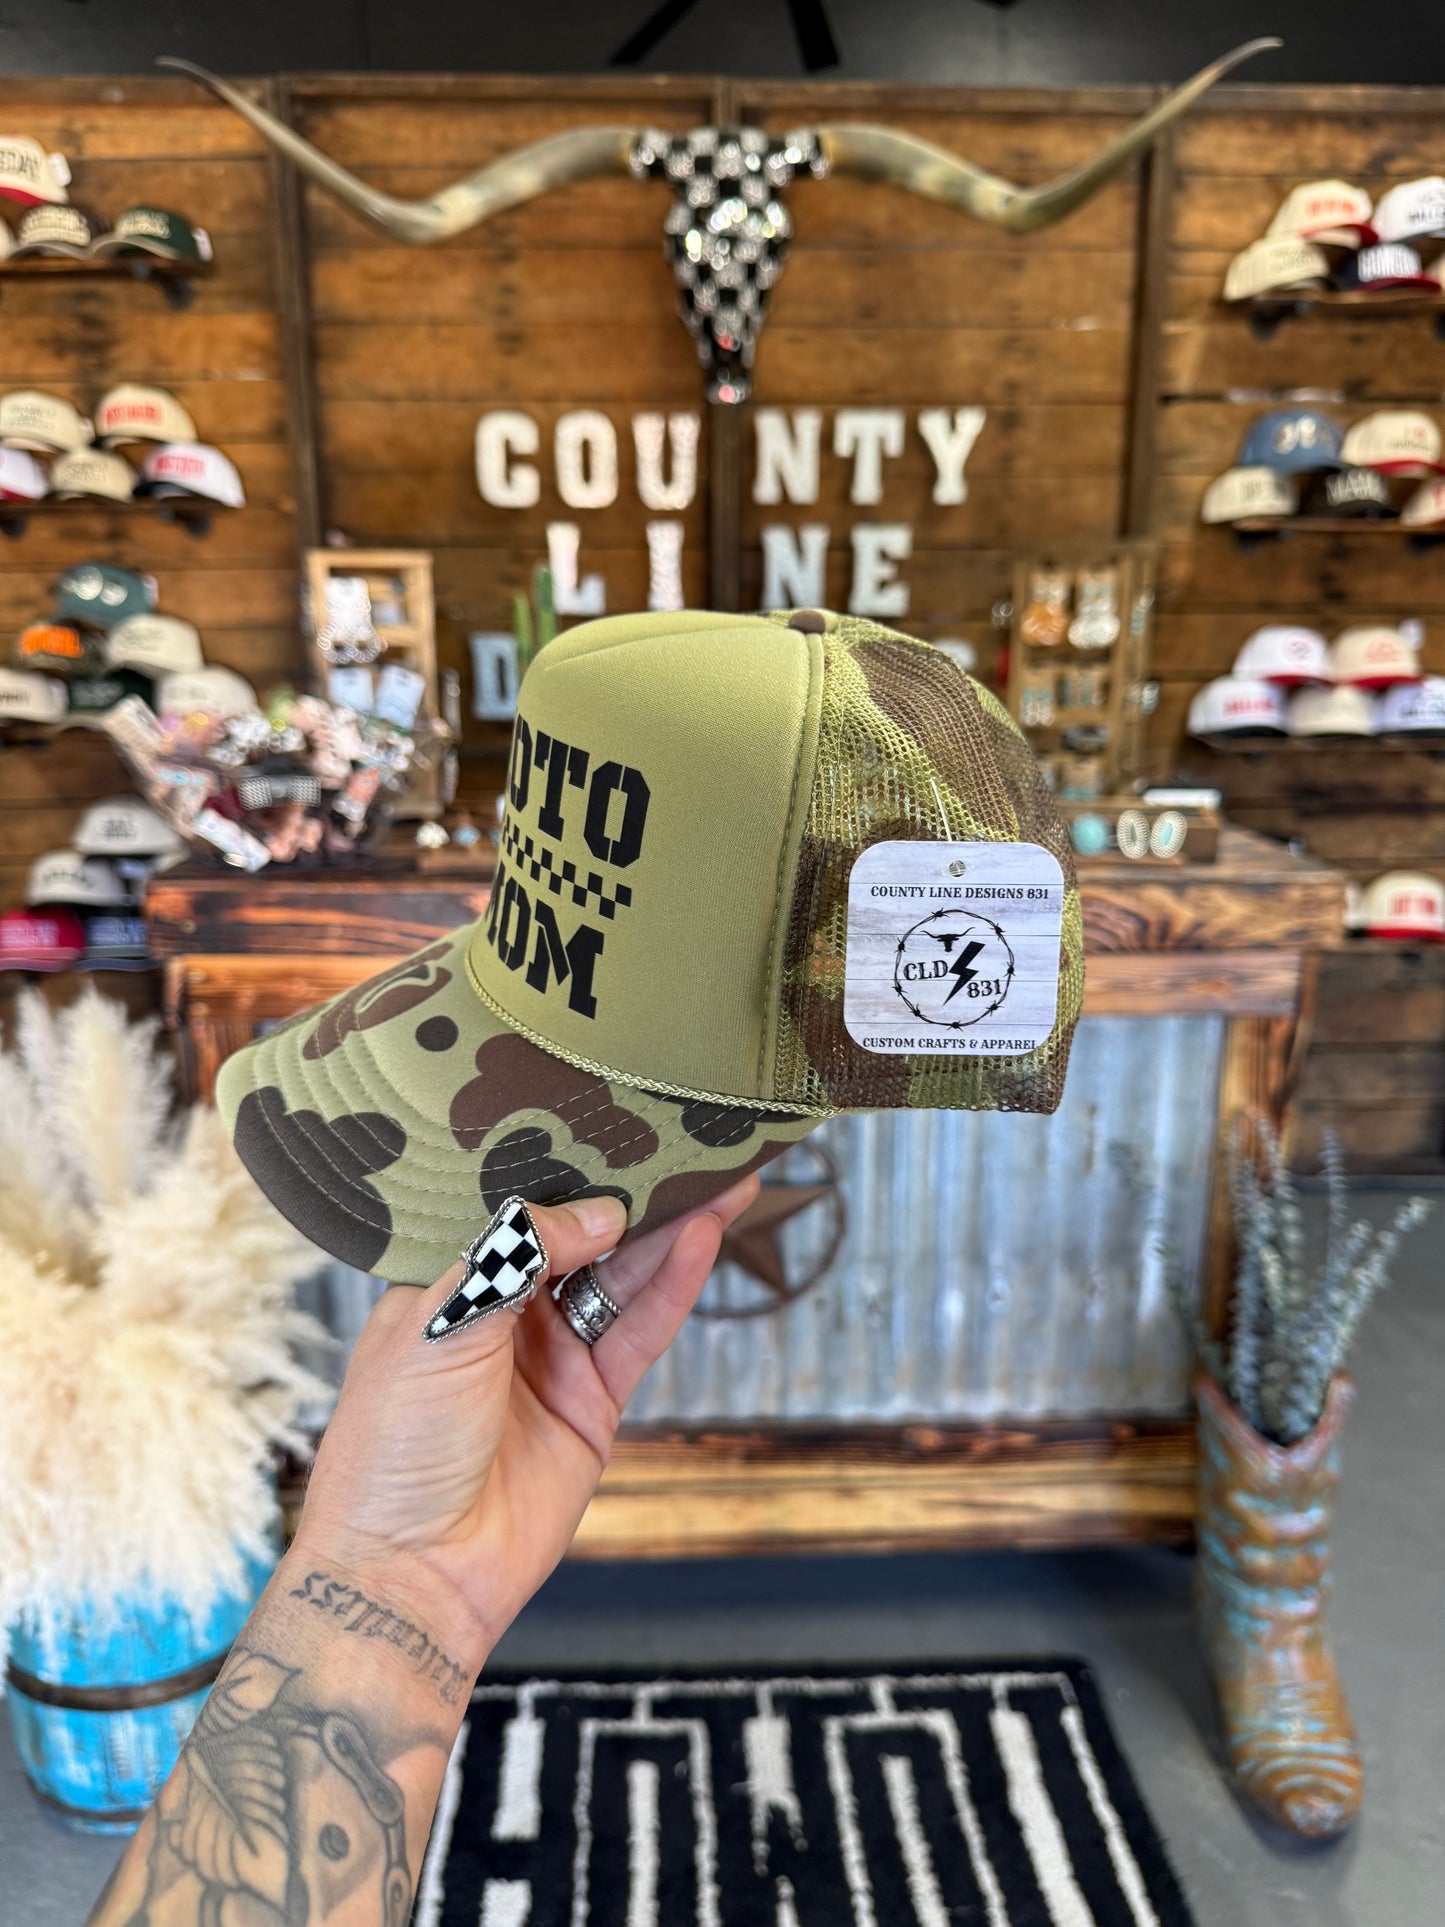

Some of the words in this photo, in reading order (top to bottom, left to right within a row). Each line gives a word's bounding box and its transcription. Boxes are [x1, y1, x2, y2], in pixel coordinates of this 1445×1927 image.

[474, 409, 987, 510] COUNTY
[547, 522, 912, 616] LINE
[508, 714, 651, 869] OTO
[871, 885, 926, 898] COUNTY
[929, 887, 962, 898] LINE
[965, 887, 1024, 899] DESIGNS
[1027, 888, 1049, 899] 831
[903, 960, 948, 981] CLD
[967, 979, 1002, 998] 831
[863, 1037, 915, 1048] CUSTOM
[918, 1038, 966, 1049] CRAFTS
[969, 1038, 978, 1049] &
[980, 1039, 1037, 1050] APPAREL
[289, 1571, 469, 1707] Relentless
